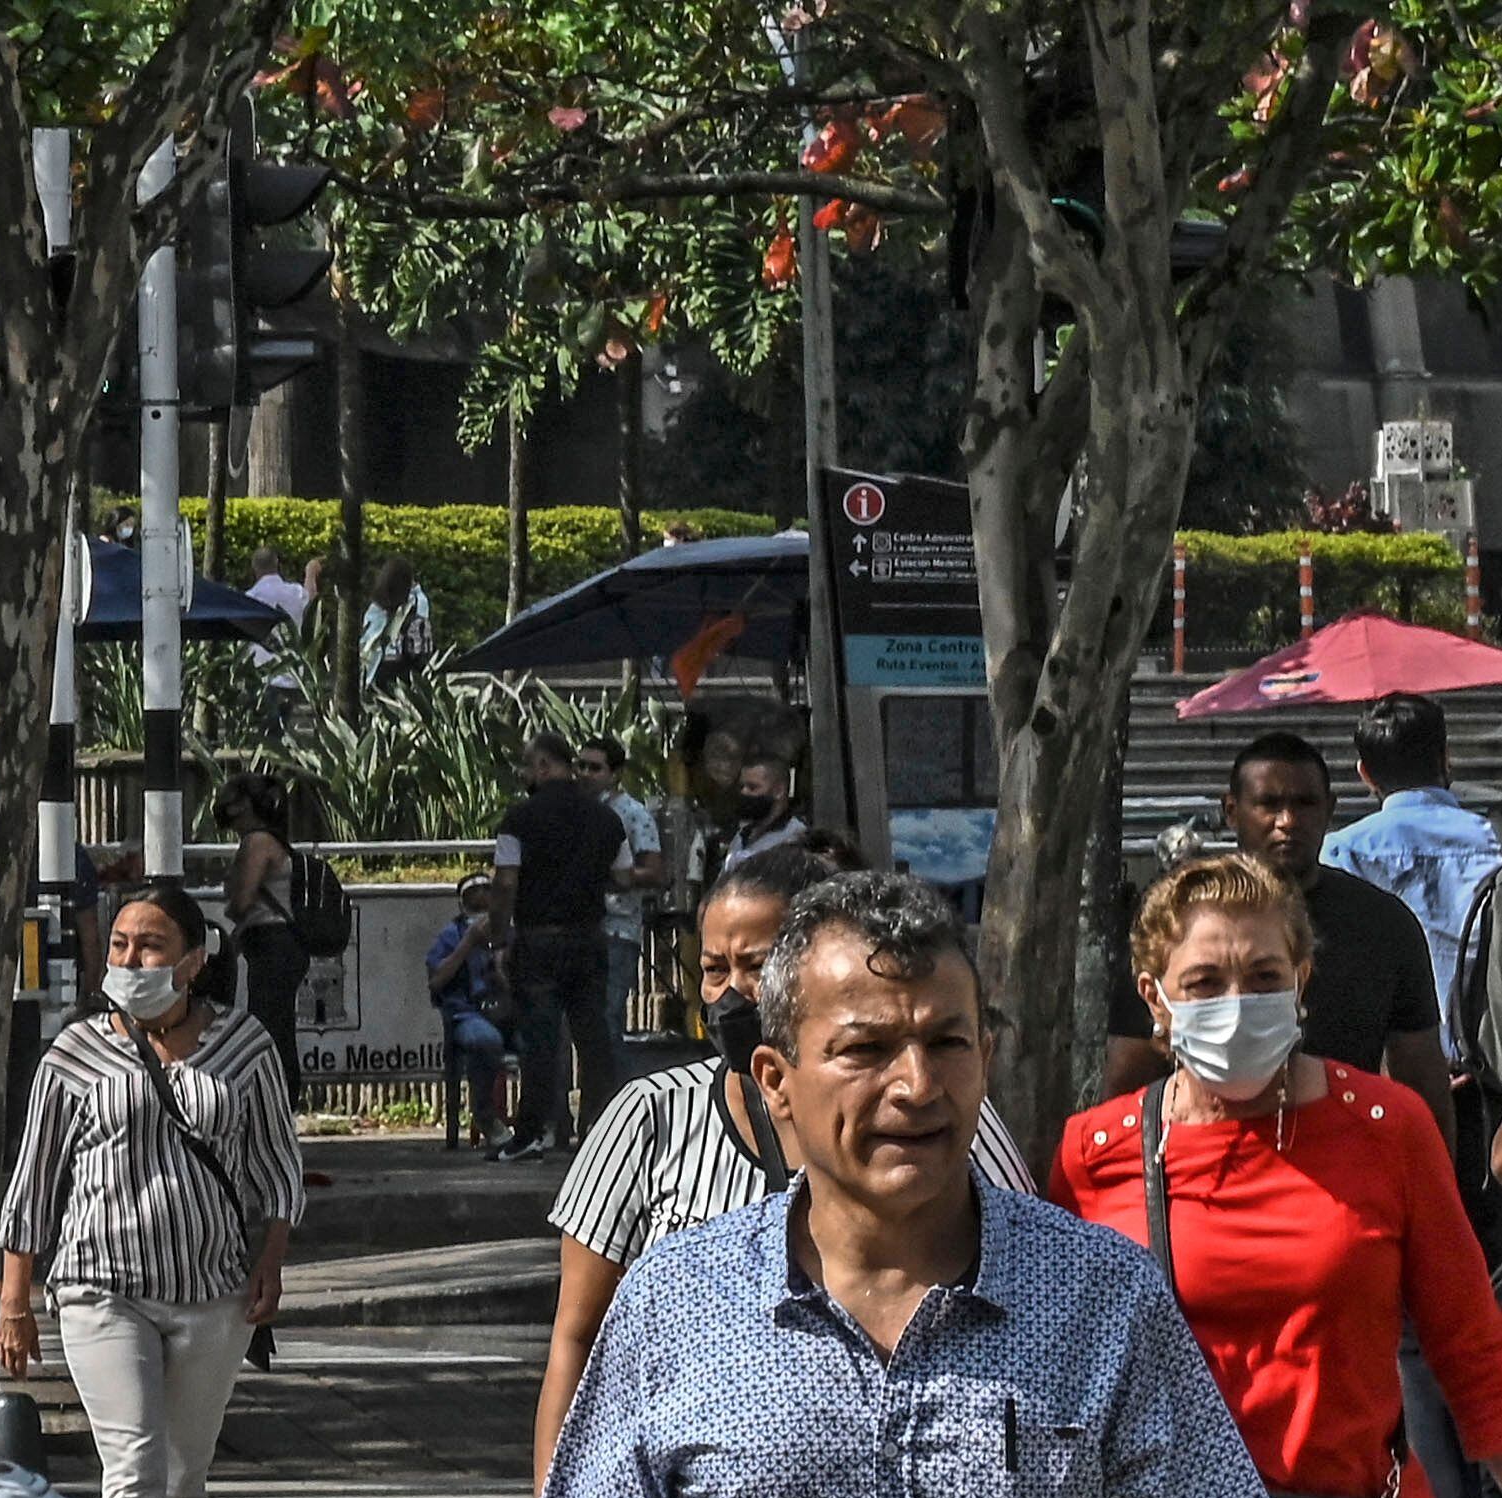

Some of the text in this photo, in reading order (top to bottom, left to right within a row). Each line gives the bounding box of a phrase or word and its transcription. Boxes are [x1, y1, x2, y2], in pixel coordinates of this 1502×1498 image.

[885, 639, 980, 653] Zona Centro
[302, 1046, 336, 1071] de
